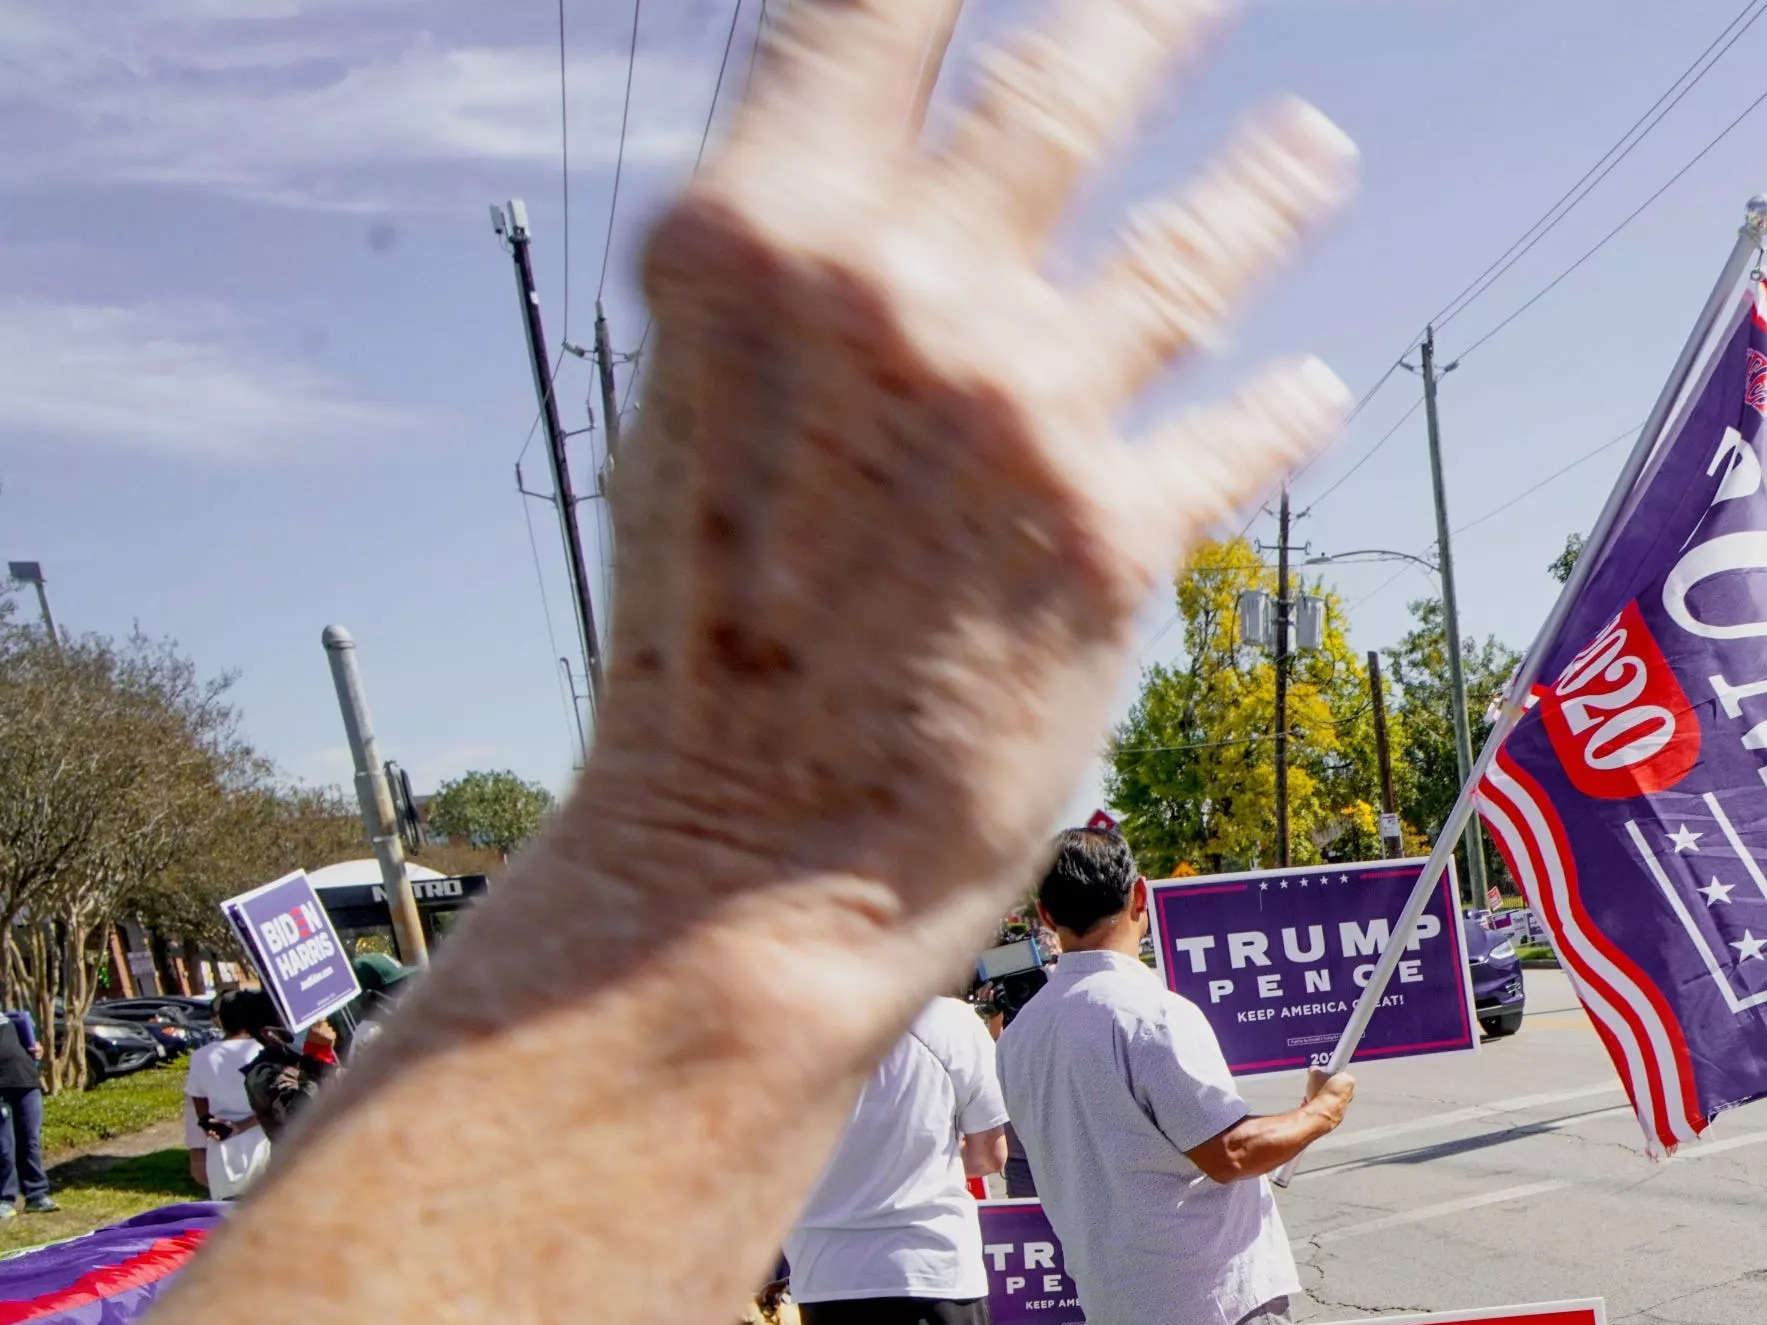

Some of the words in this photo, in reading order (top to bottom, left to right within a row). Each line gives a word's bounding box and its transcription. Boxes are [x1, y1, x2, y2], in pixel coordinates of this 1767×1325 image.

[259, 900, 323, 954] BIDEN
[1176, 913, 1441, 974] TRUMP
[274, 932, 335, 981] HARRIS
[1209, 959, 1424, 1003] PENCE
[1237, 1006, 1275, 1023] KEEP
[1281, 1001, 1348, 1018] AMERICA
[1025, 1300, 1055, 1310] KEEP
